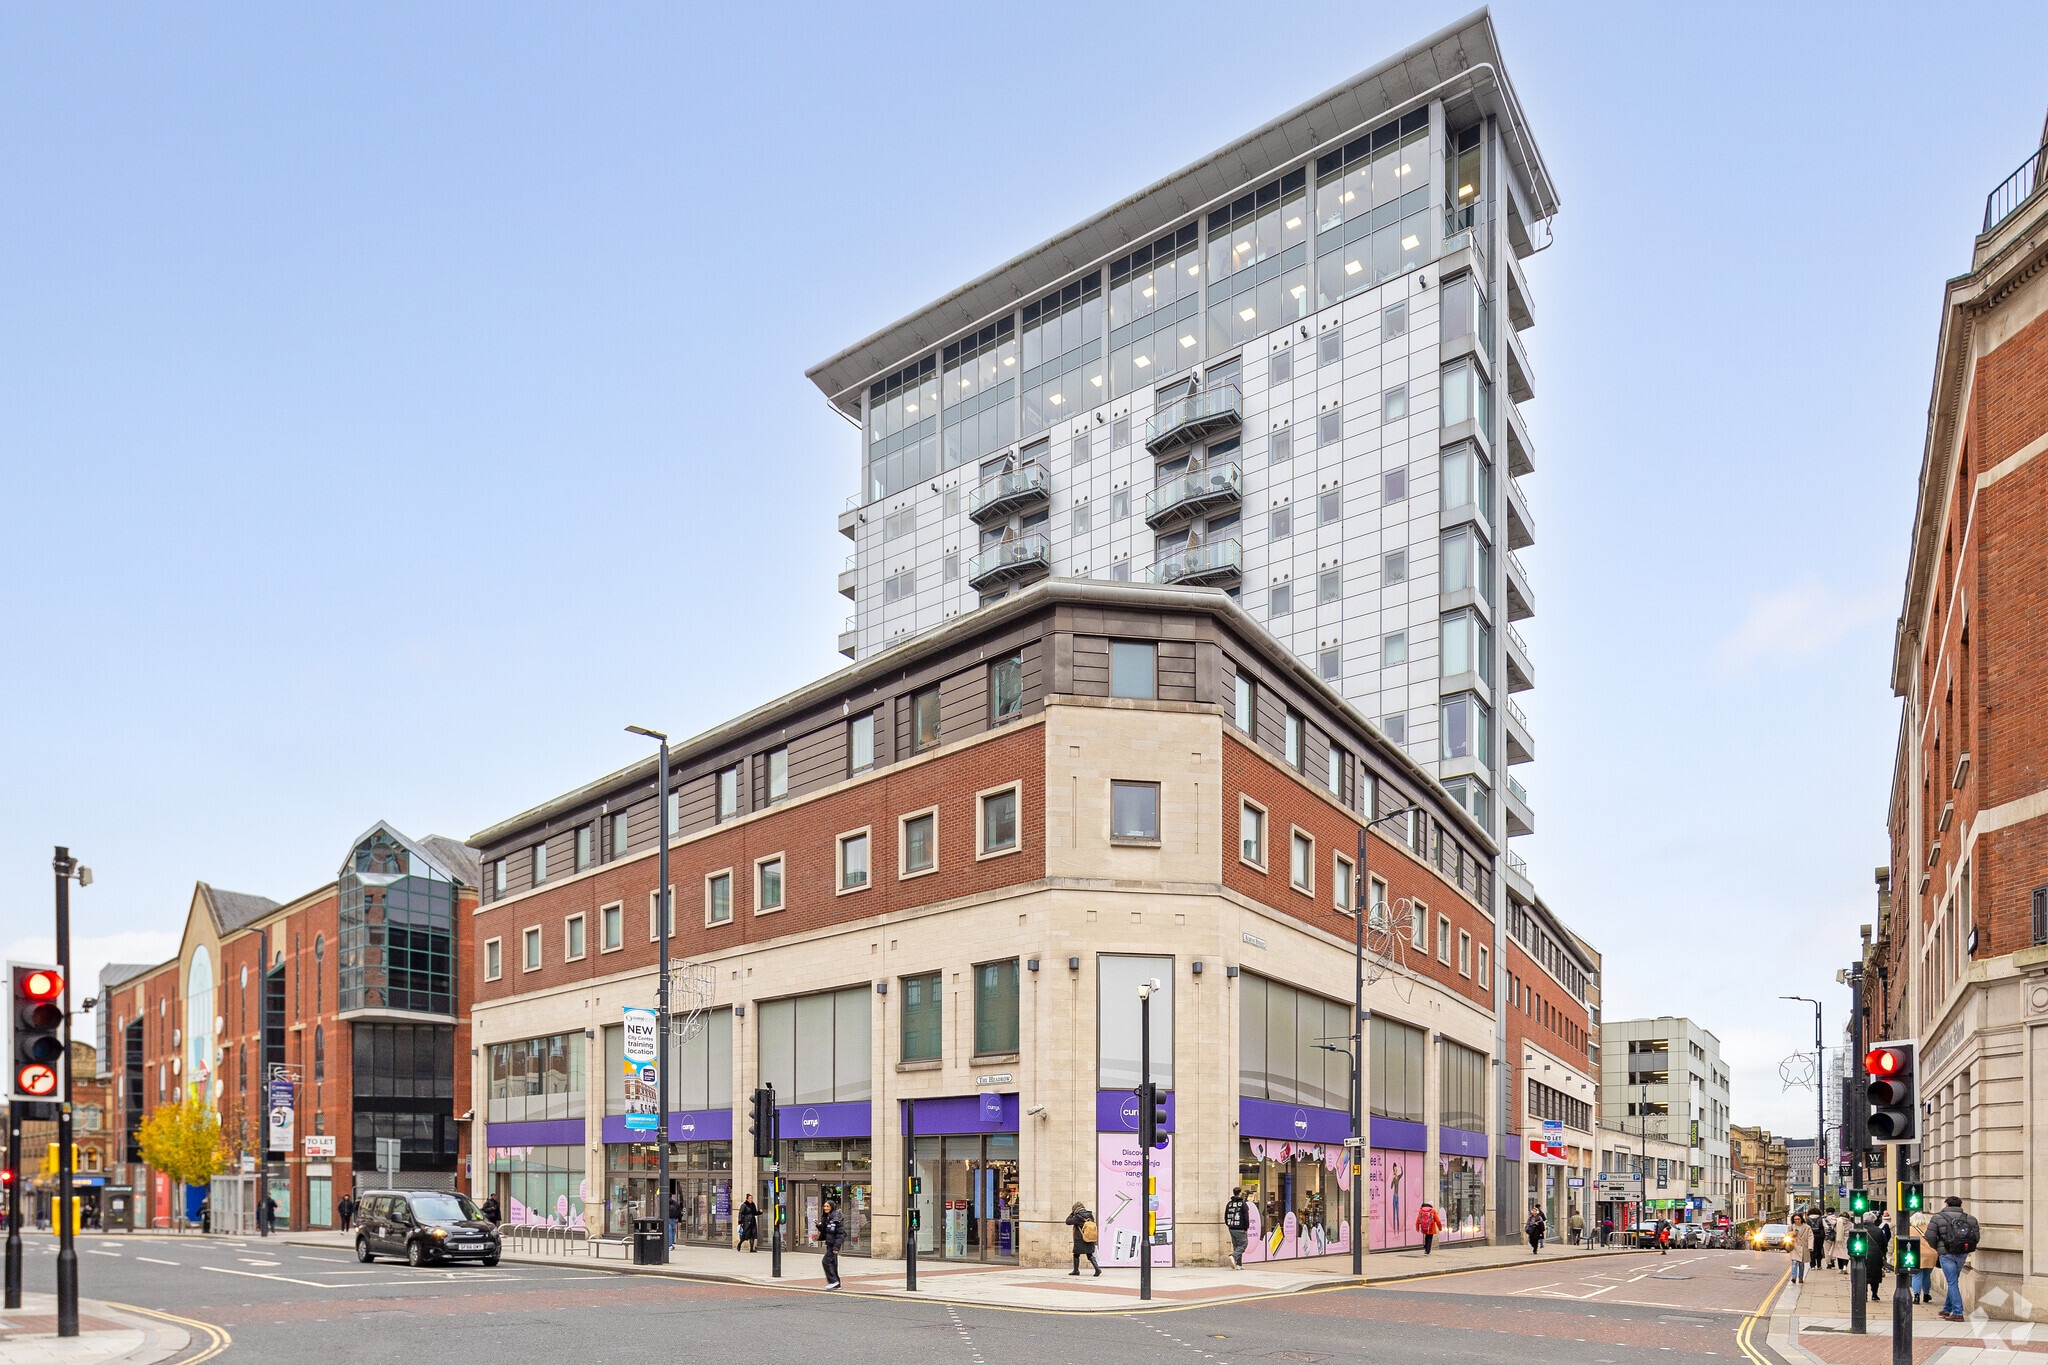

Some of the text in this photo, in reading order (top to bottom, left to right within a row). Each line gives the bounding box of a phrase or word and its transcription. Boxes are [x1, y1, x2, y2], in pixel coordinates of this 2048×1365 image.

[628, 1024, 653, 1034] NEW
[628, 1041, 654, 1049] training
[803, 1118, 818, 1128] currys
